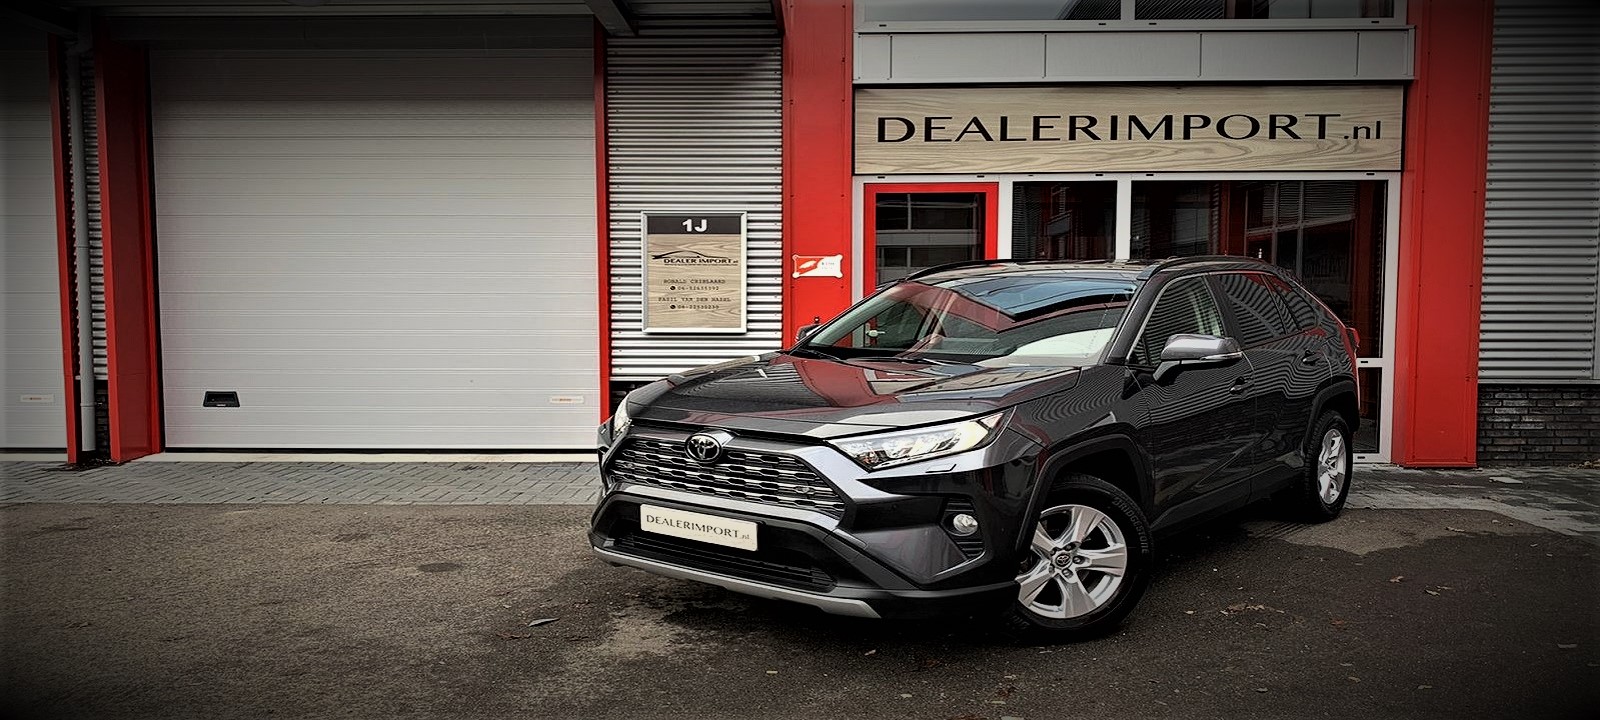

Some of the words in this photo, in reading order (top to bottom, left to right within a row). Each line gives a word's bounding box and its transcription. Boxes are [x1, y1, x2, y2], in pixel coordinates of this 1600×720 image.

[876, 113, 1382, 143] DEALERIMPORT.nl
[682, 218, 708, 232] 1J
[646, 514, 751, 540] DEALERIMPORT.nl
